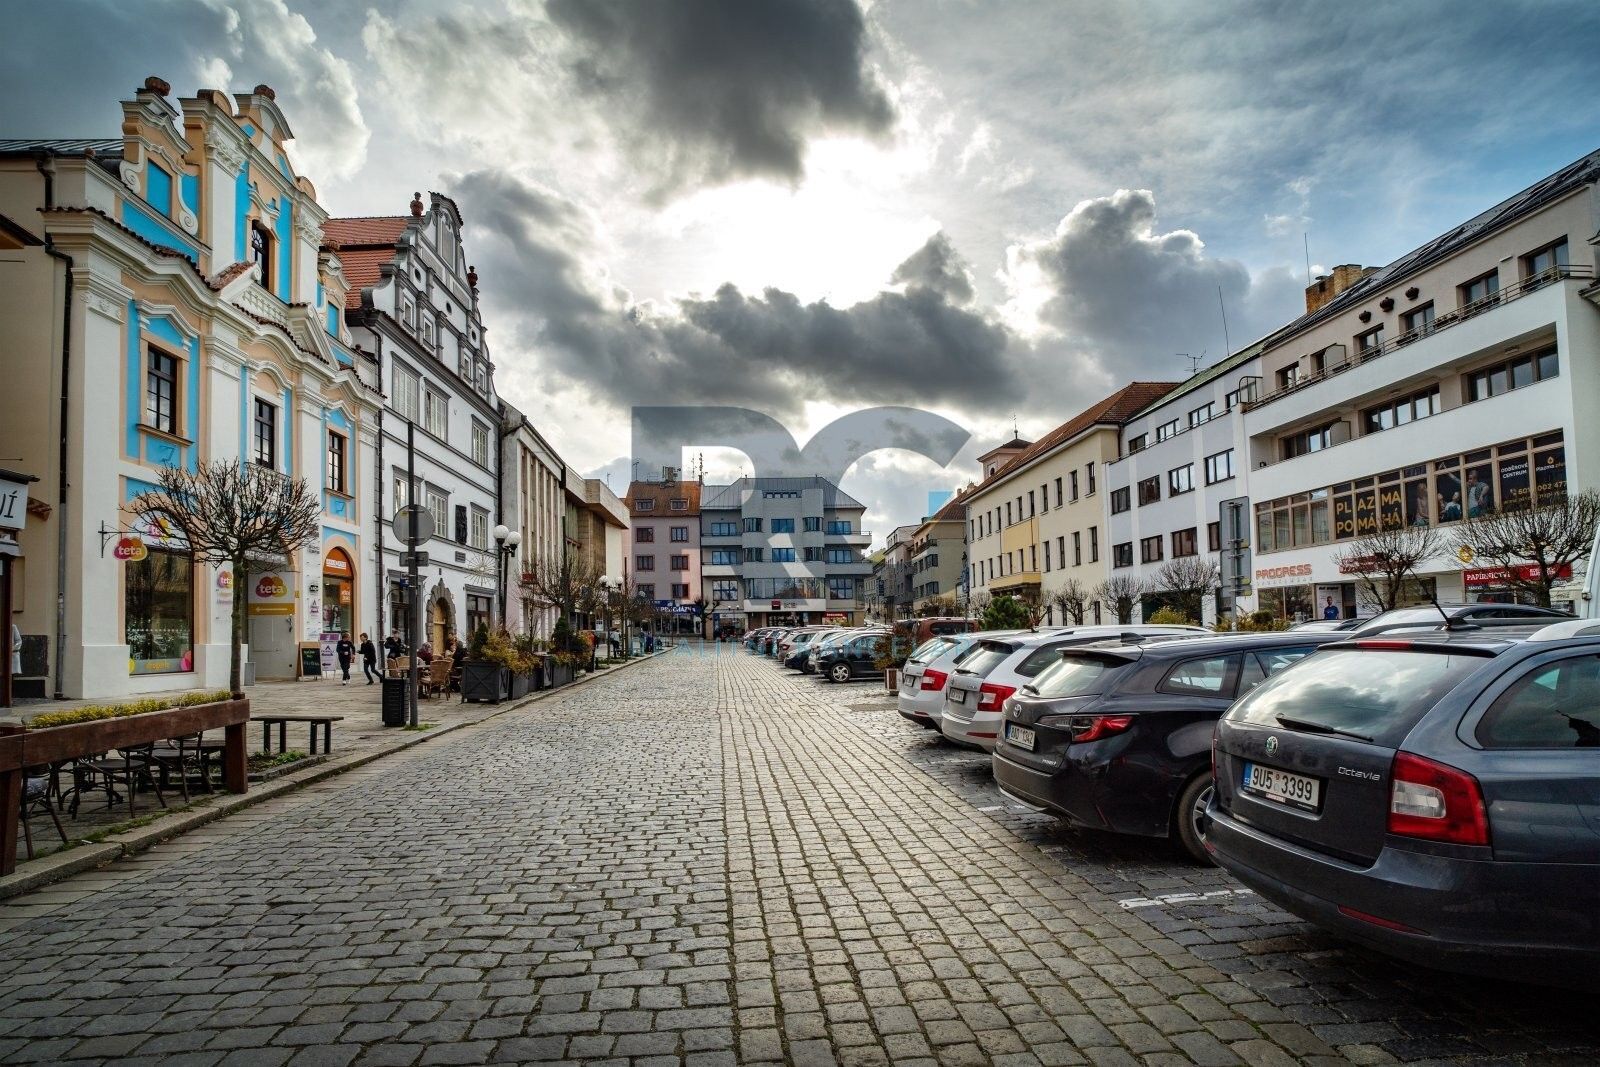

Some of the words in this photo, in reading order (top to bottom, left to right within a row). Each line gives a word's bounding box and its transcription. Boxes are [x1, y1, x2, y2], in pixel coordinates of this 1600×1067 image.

[1503, 469, 1527, 479] CENTRUM
[118, 546, 142, 556] teta
[1256, 564, 1313, 580] PROGRESS
[259, 585, 283, 594] teta
[1337, 766, 1381, 781] Octavia
[1252, 767, 1274, 790] 9U5
[1281, 774, 1313, 801] 3399
